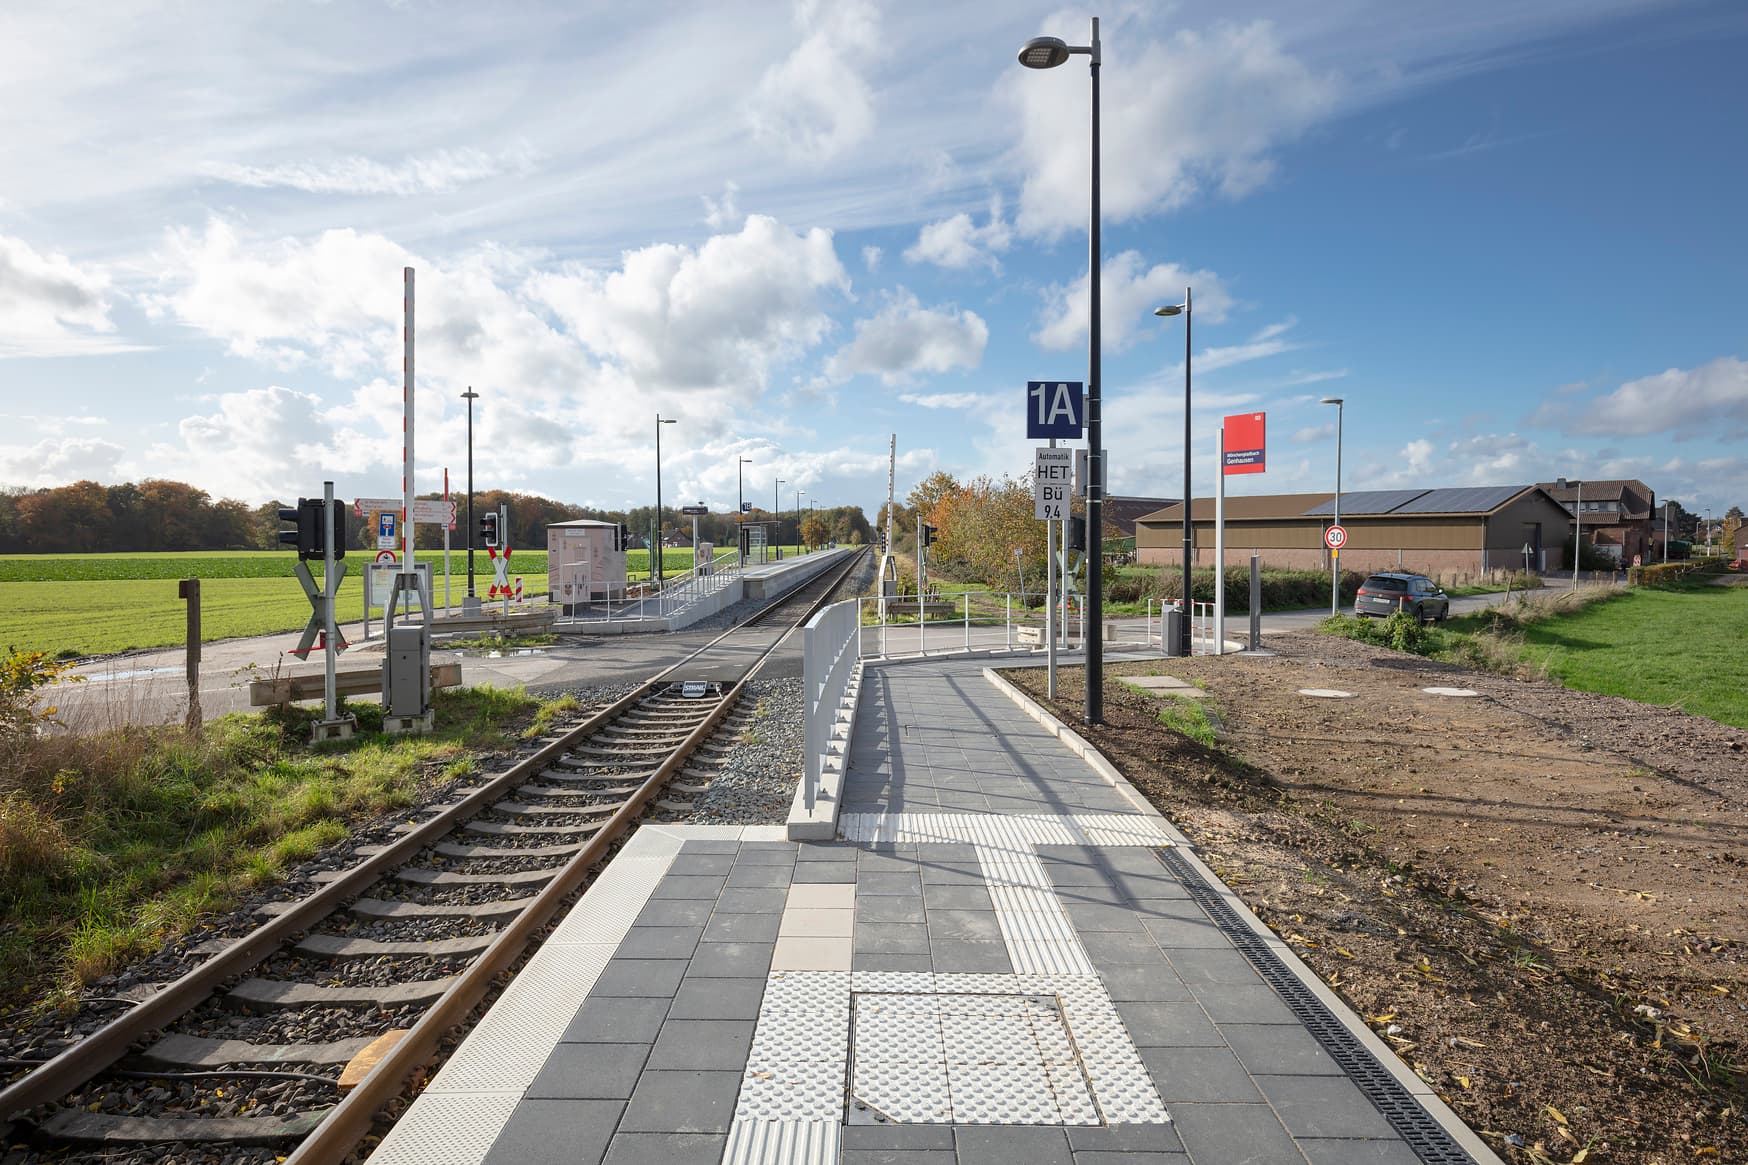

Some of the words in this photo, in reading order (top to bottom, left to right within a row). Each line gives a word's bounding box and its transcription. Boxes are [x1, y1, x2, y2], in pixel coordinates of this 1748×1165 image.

[1030, 383, 1077, 425] 1A
[1038, 452, 1069, 460] Automatik
[1037, 465, 1070, 479] HET
[1043, 486, 1063, 500] Bü
[1044, 504, 1060, 519] 9.4
[1330, 532, 1342, 542] 30
